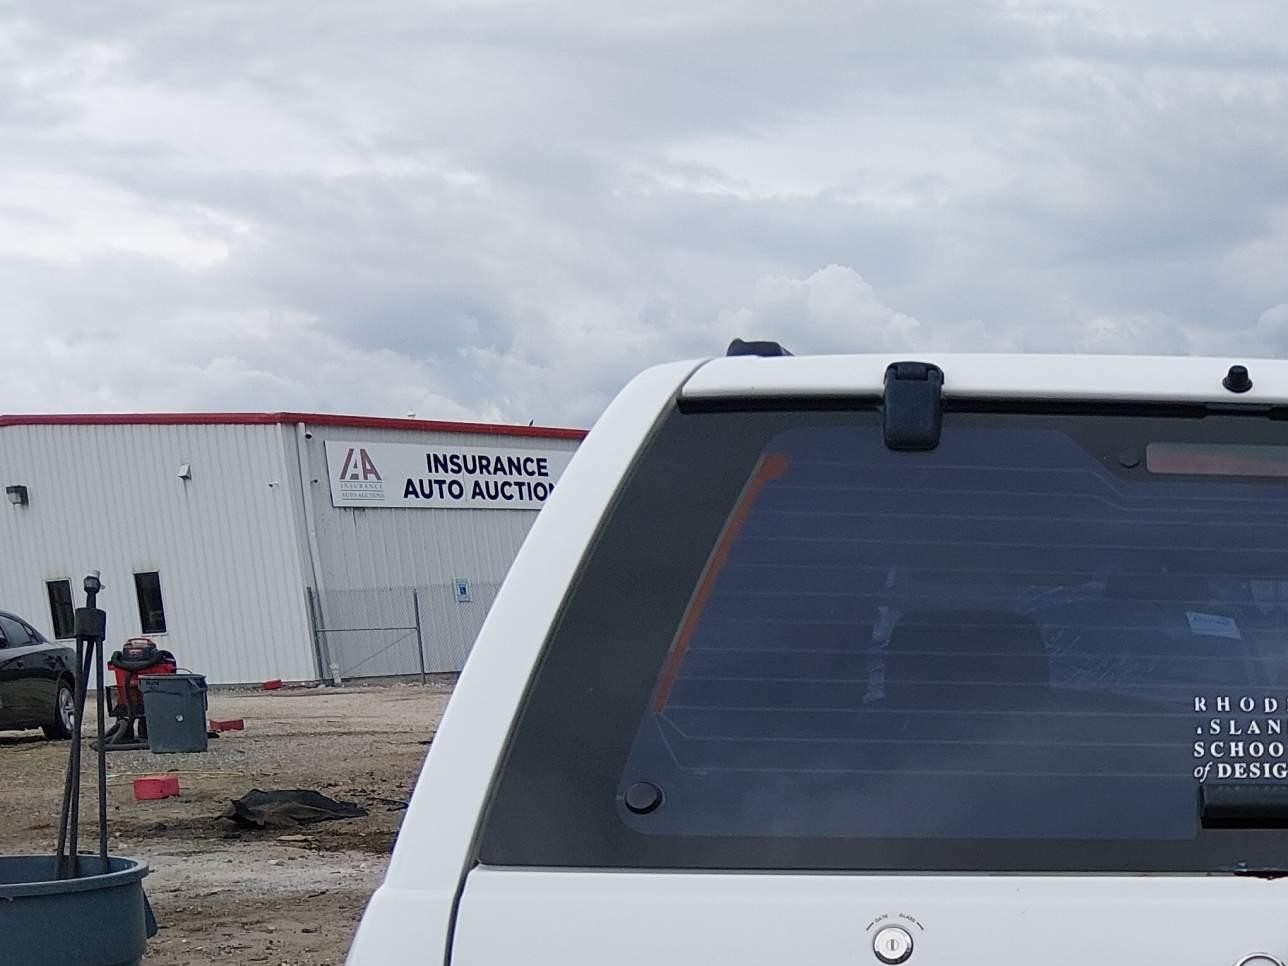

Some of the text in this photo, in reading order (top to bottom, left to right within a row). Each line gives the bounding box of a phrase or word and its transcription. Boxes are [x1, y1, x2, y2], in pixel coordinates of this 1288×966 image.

[426, 453, 549, 477] INSURANCE
[404, 479, 464, 499] AUTO
[1194, 761, 1214, 783] of
